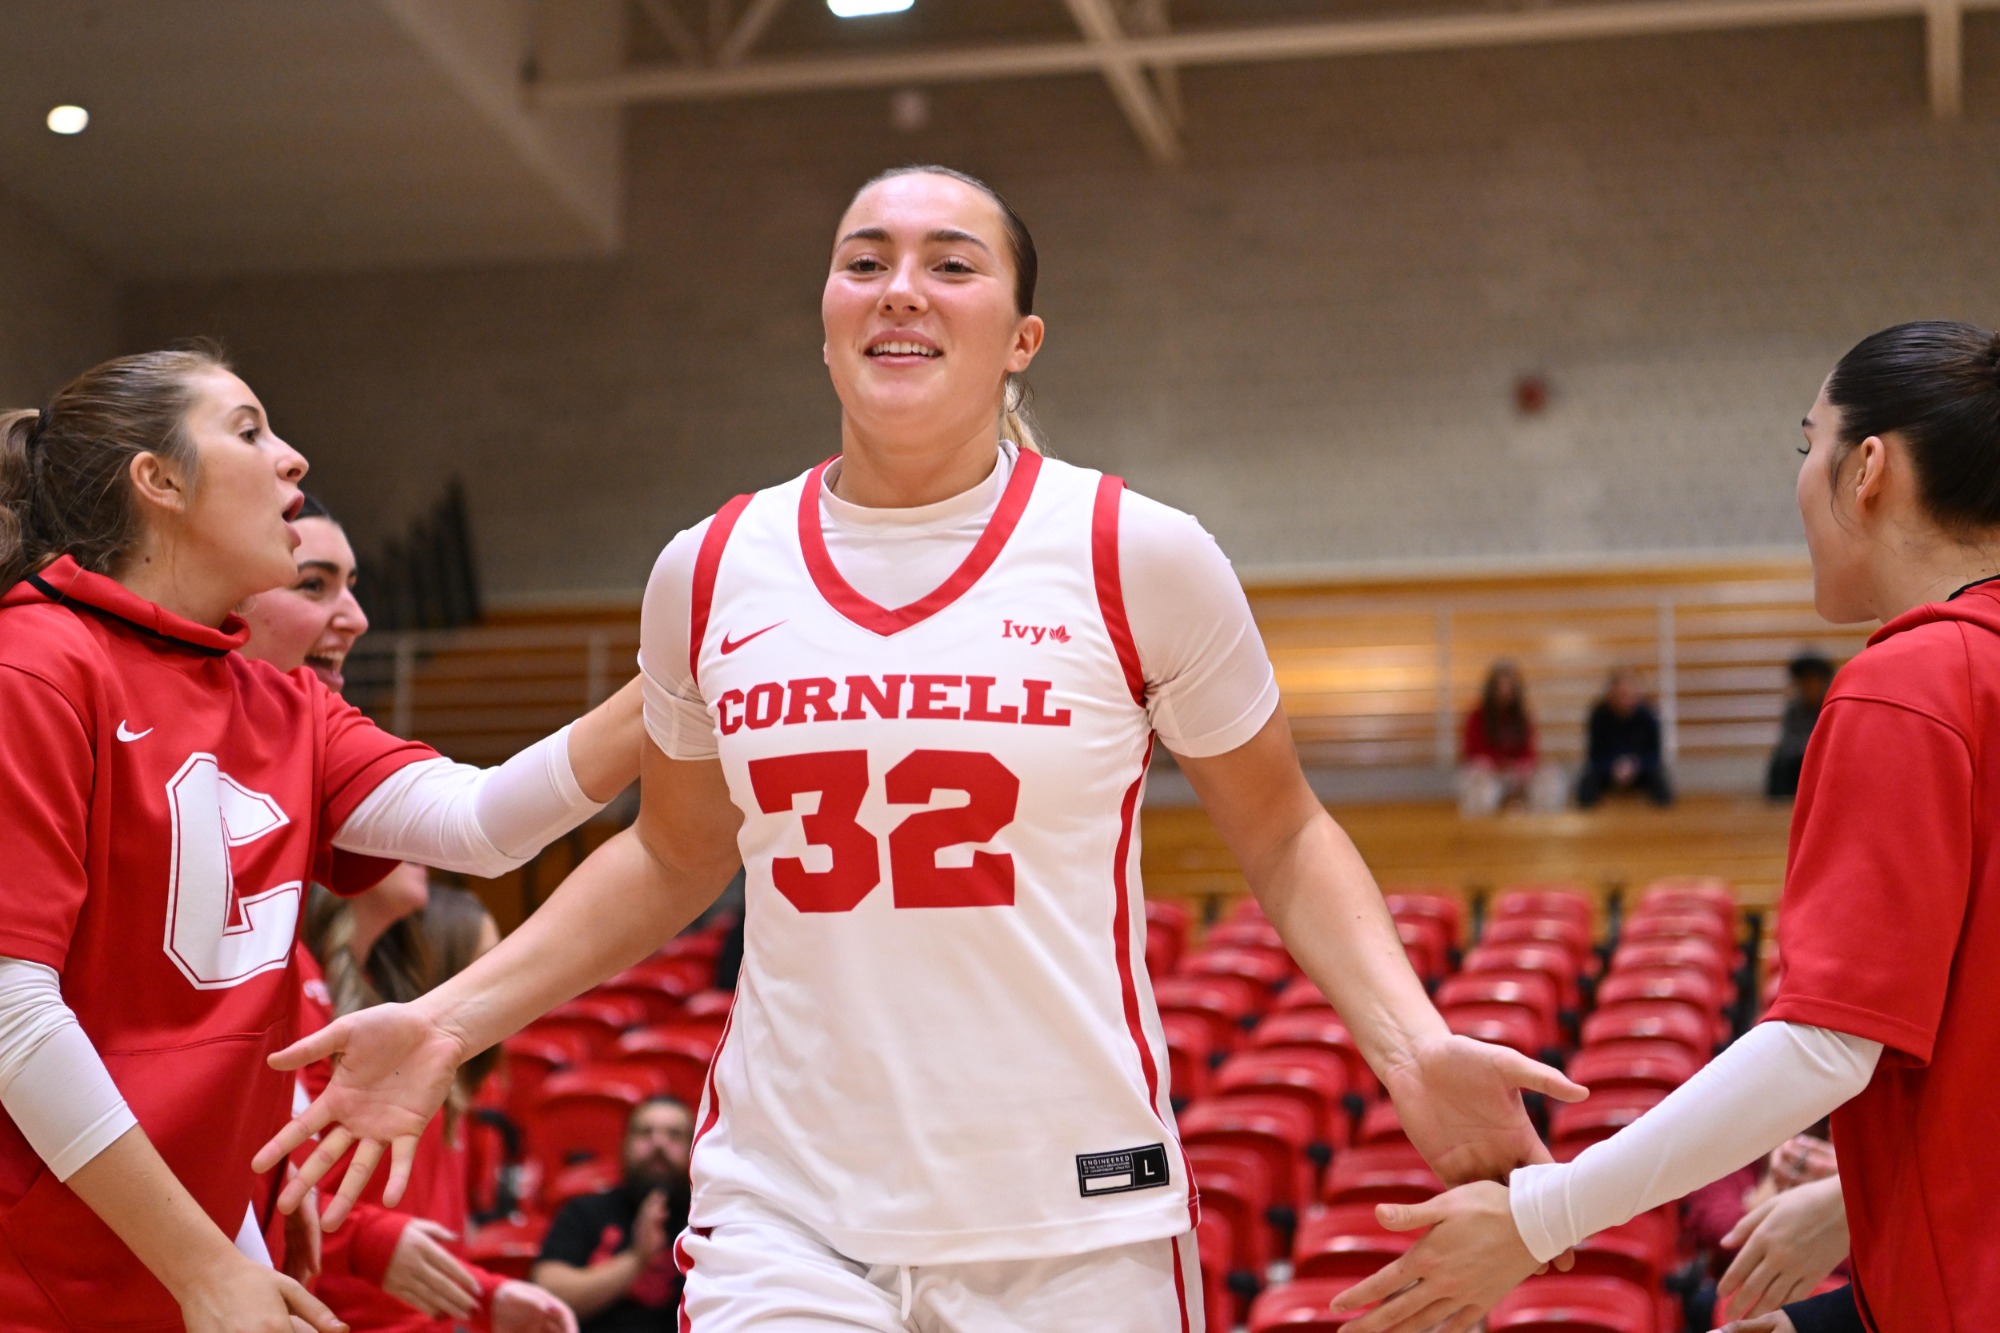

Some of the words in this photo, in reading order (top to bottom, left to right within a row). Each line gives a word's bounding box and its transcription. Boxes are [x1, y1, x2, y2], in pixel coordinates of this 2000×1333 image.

[1002, 619, 1047, 645] Ivy
[717, 674, 1071, 736] CORNELL
[748, 749, 1020, 913] 32
[163, 752, 302, 990] C
[1082, 1155, 1130, 1166] ENGINEERED
[1144, 1159, 1155, 1176] L
